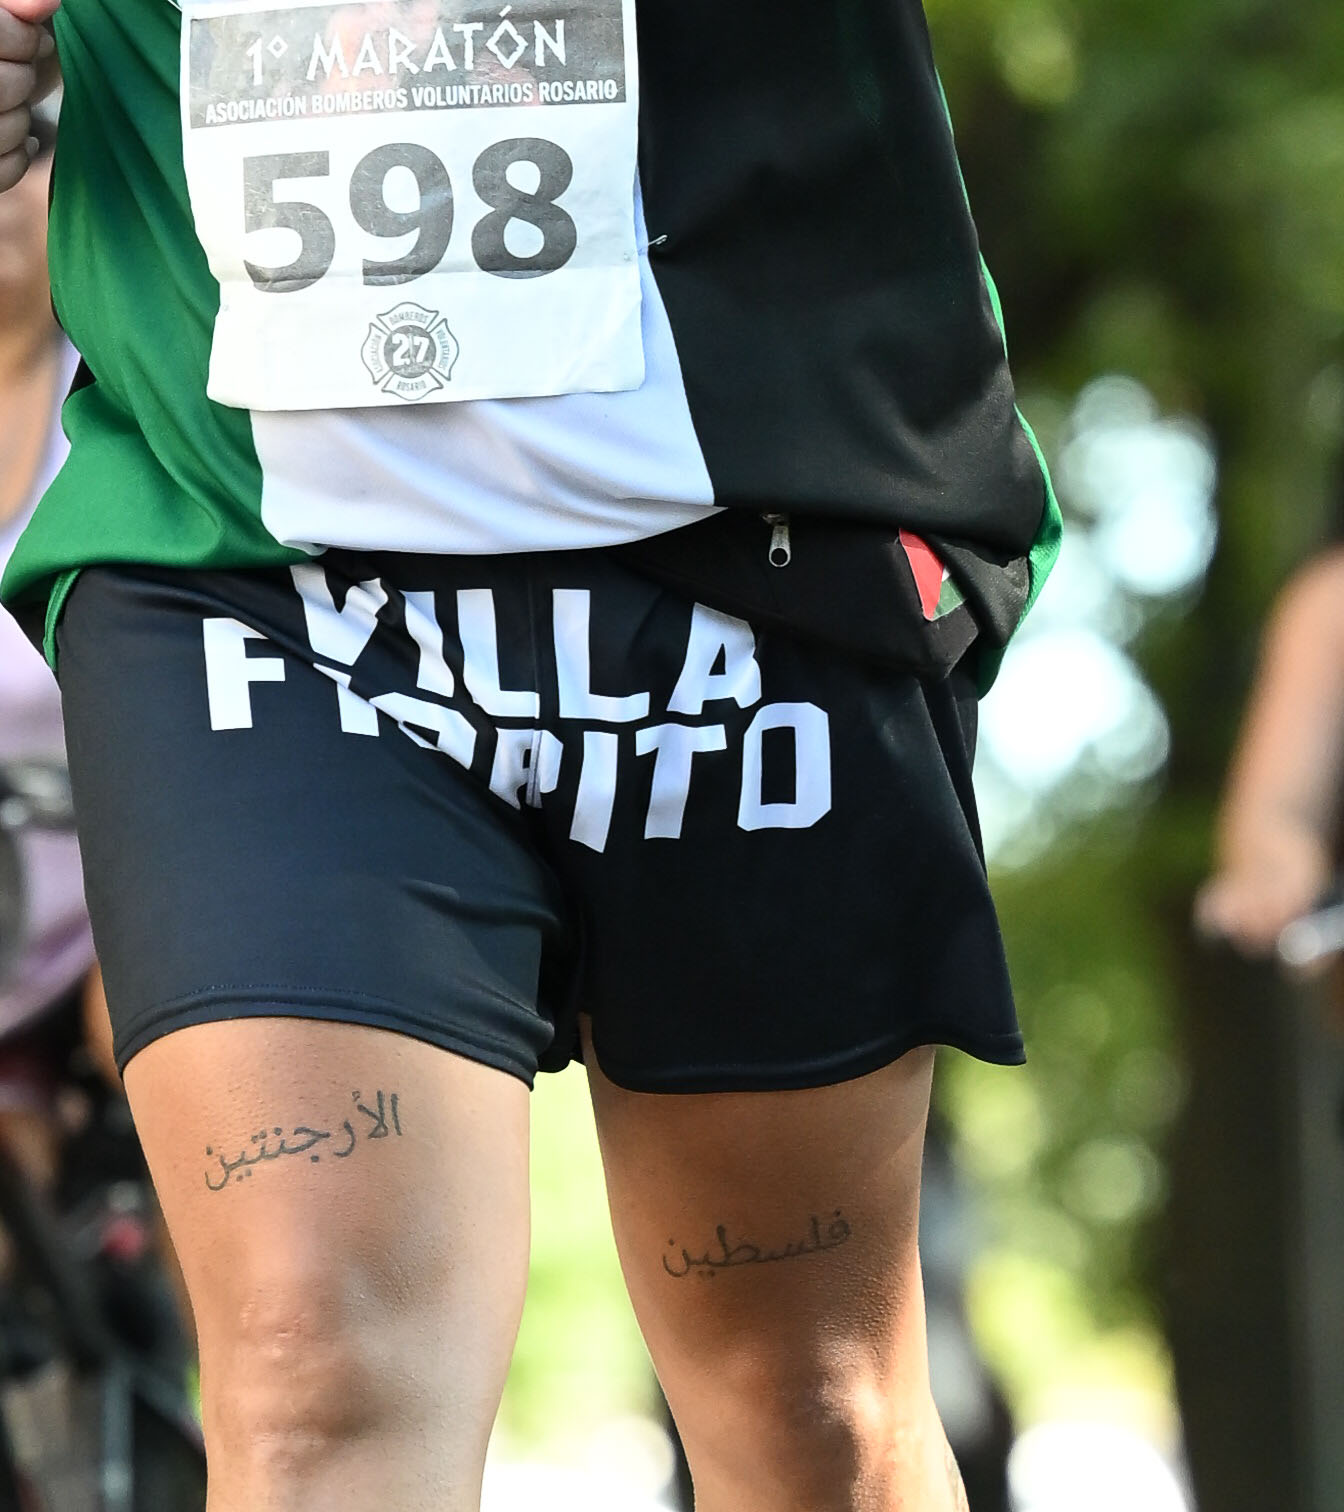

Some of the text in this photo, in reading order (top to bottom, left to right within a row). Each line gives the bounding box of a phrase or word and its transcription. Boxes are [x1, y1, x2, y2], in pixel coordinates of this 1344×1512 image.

[306, 5, 567, 82] MARATÓN
[205, 79, 619, 125] ASOCIACIÓN BOMBEROS VOLUNTARIOS ROSARIO
[242, 137, 578, 294] 598
[391, 332, 431, 367] 27
[289, 563, 762, 723] VILLA
[661, 1208, 854, 1279] فلسطين
